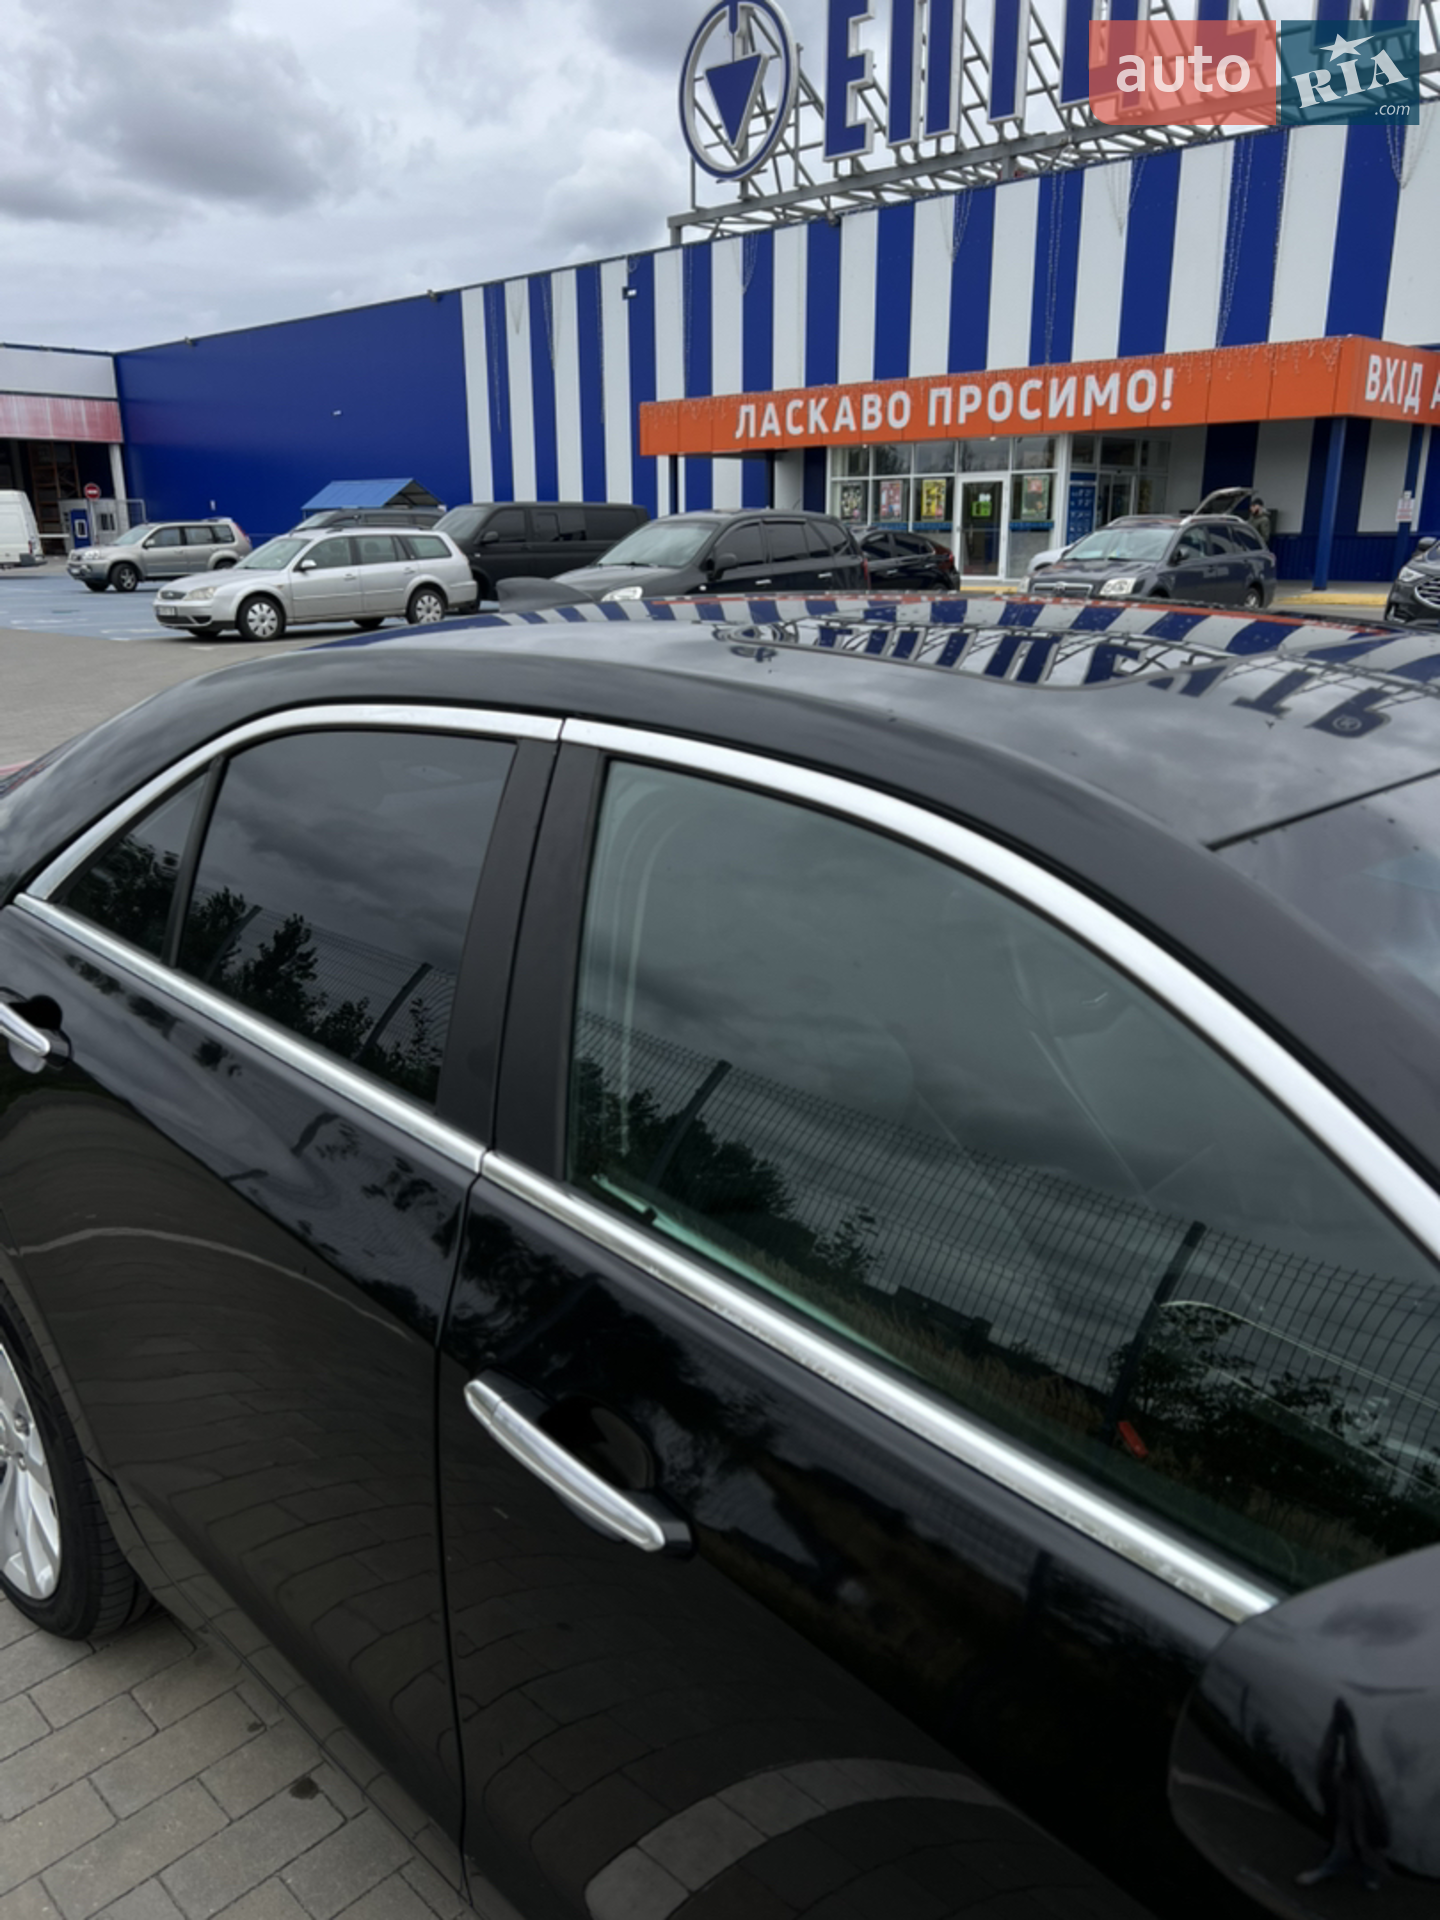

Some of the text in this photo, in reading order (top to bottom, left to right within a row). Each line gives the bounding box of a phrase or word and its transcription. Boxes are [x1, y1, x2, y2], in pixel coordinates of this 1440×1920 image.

[735, 367, 1174, 439] ЛАСКАВО ПРОСИМО!
[1365, 354, 1423, 414] ВХІД
